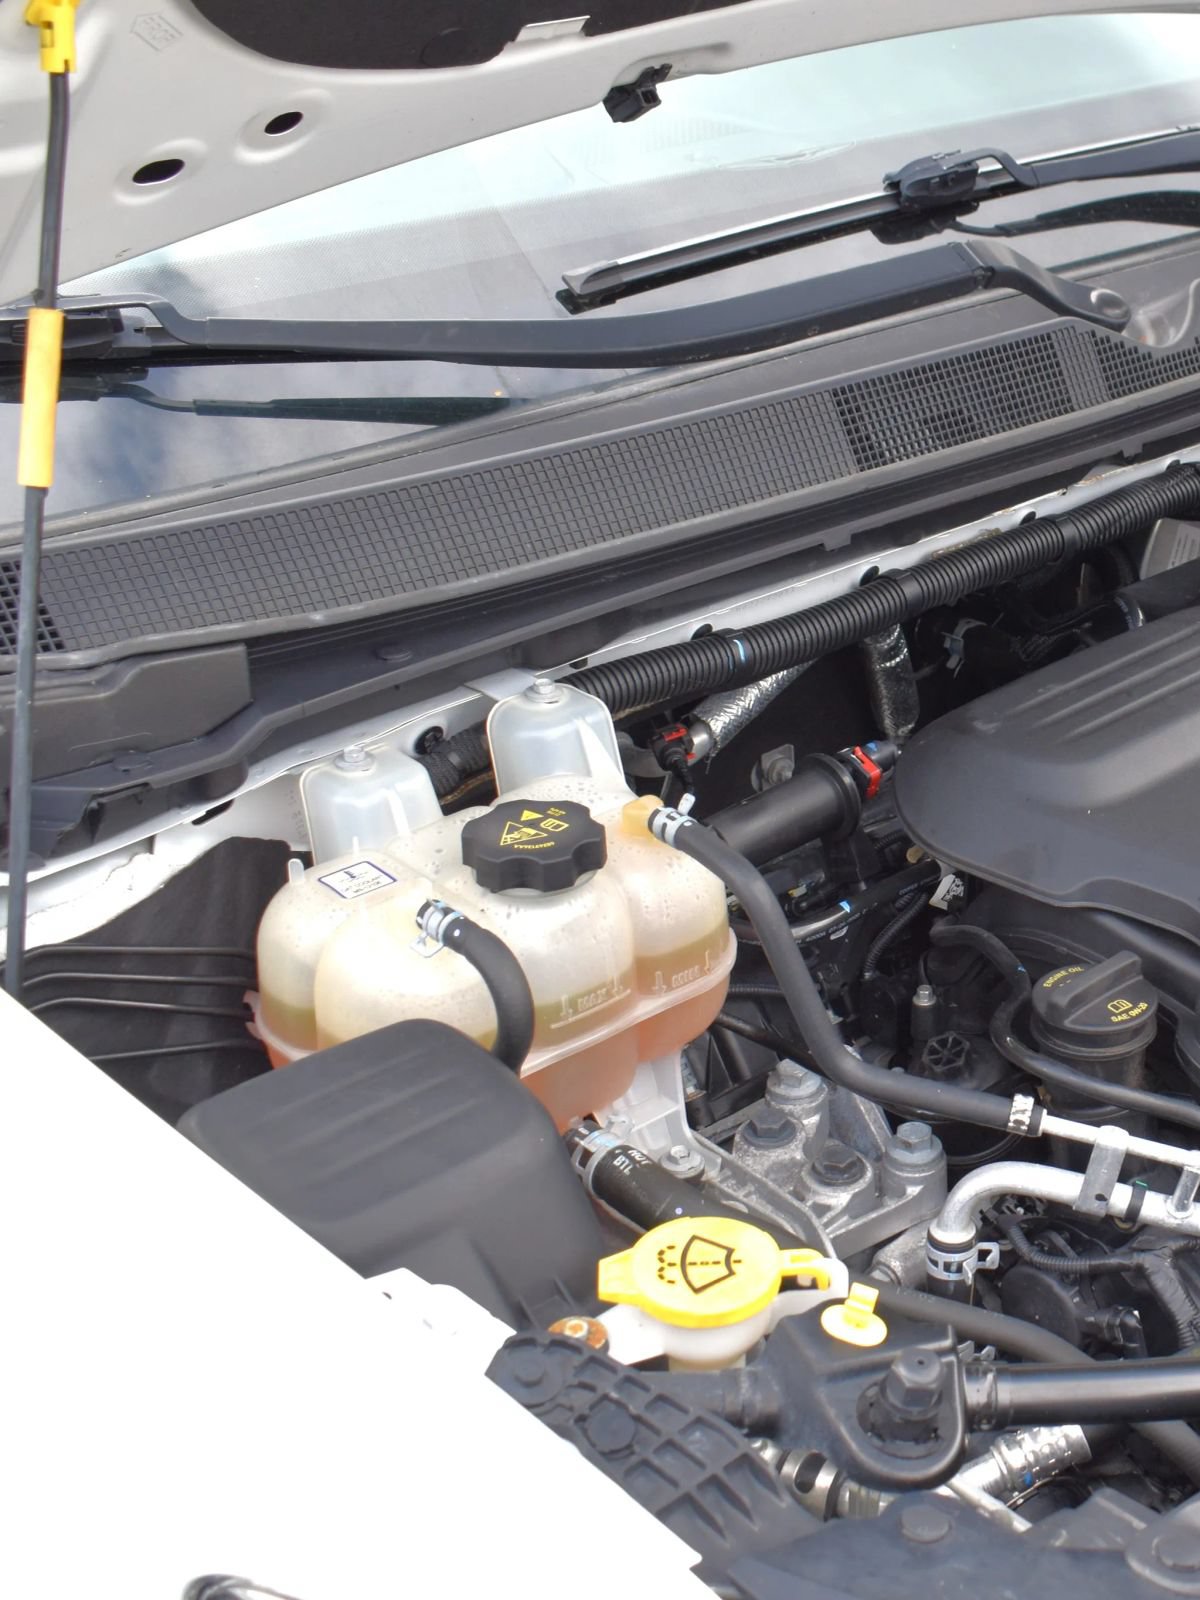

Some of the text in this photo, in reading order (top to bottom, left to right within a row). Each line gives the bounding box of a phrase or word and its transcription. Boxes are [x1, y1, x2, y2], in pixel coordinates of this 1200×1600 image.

[1042, 965, 1085, 988] ENGINE OIL
[1110, 1013, 1131, 1023] SAE
